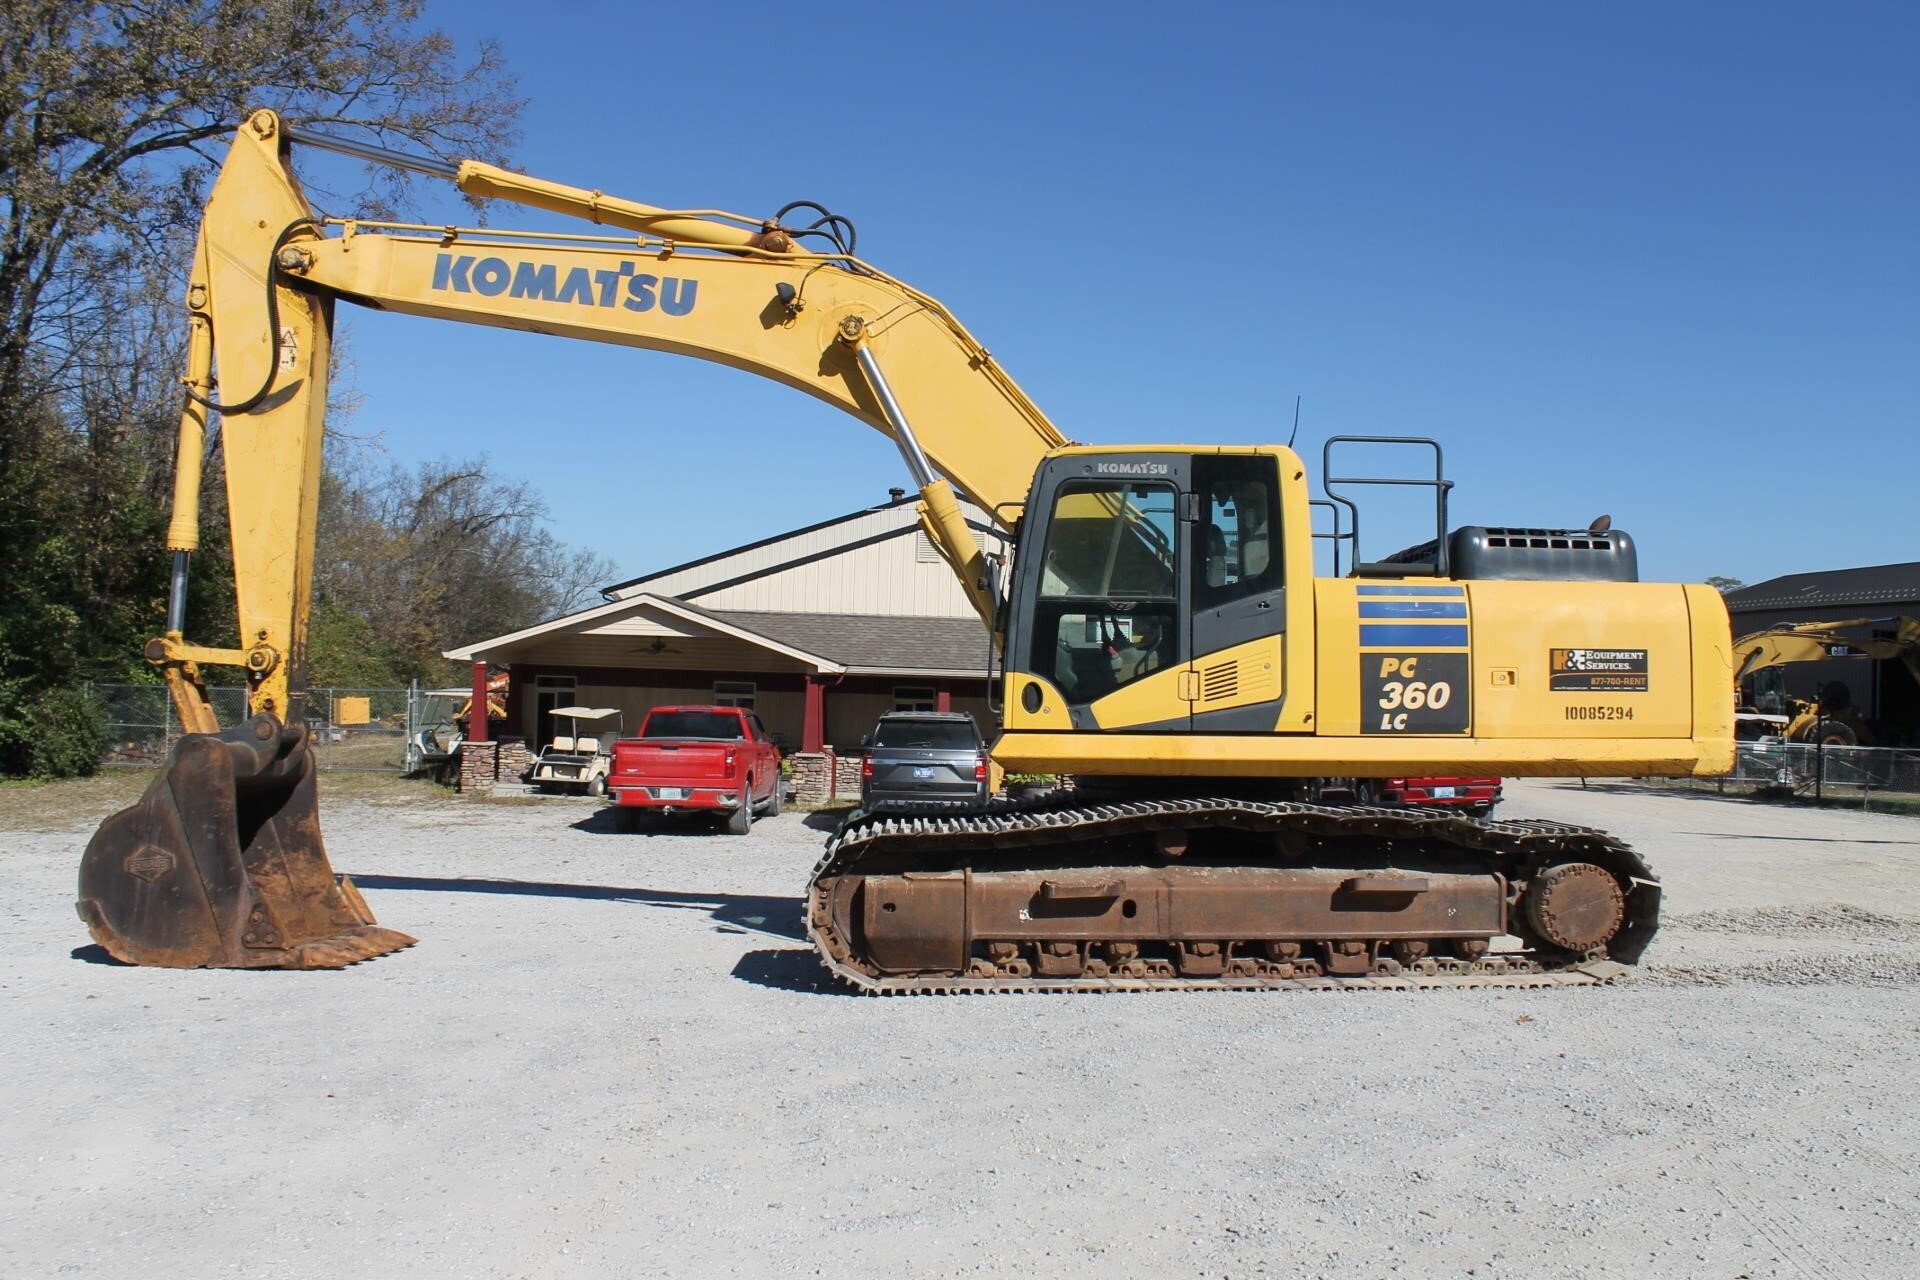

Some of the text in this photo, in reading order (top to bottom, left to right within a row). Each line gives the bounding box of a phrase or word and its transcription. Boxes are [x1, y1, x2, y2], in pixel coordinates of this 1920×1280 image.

[432, 253, 698, 317] KOMATSU
[1097, 461, 1169, 475] KOMATSU
[1831, 646, 1849, 657] CAT
[1379, 657, 1418, 679] PC
[1379, 682, 1451, 710] 360
[1380, 713, 1409, 730] LC
